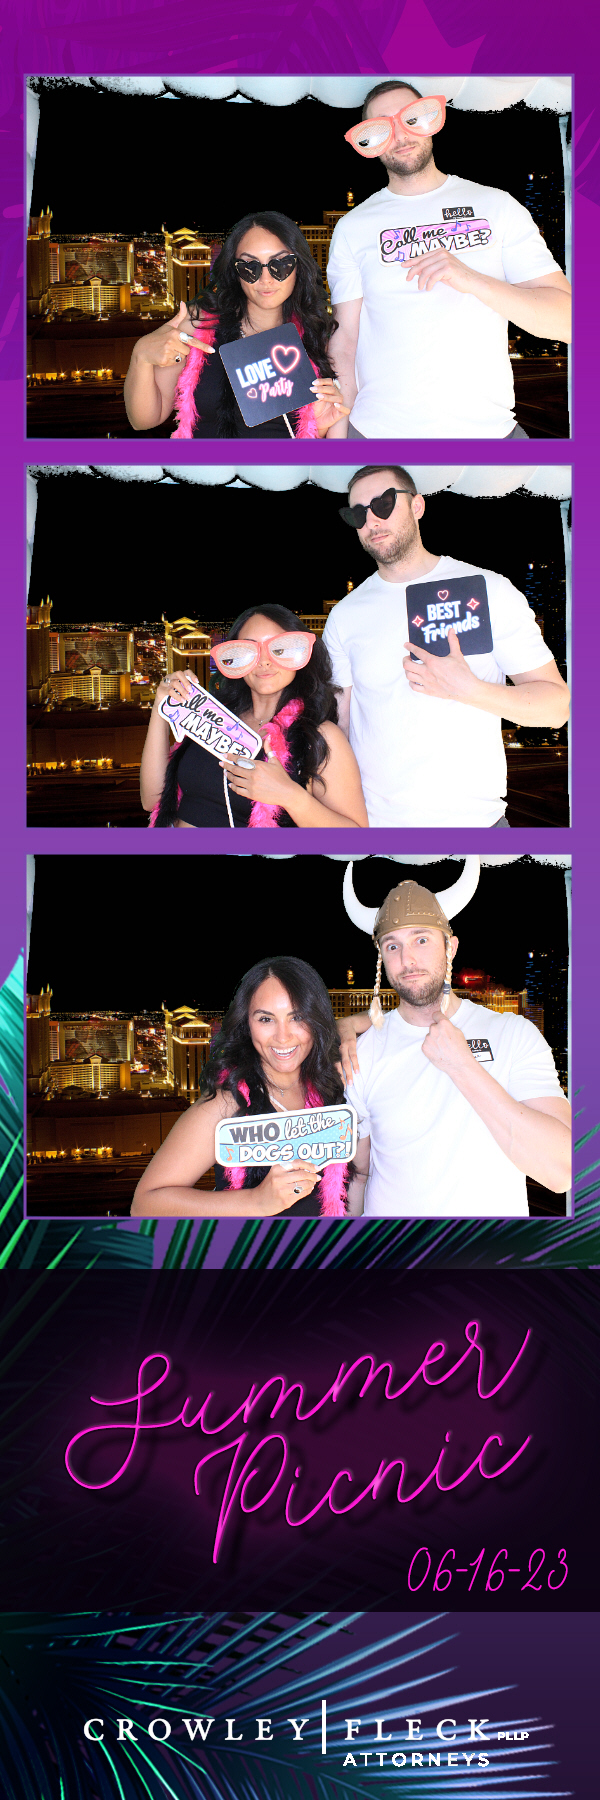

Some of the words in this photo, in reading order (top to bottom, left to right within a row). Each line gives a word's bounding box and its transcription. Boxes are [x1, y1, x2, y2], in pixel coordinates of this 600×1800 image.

[444, 207, 473, 218] hello
[381, 226, 418, 255] Call
[422, 228, 447, 240] me
[410, 228, 492, 258] MAYBE?
[235, 357, 277, 389] LOVE
[258, 376, 294, 403] Party
[426, 600, 461, 622] BEST
[421, 611, 480, 644] Friends
[203, 708, 224, 727] me
[467, 1039, 489, 1050] ello
[229, 1122, 280, 1144] WHO
[284, 1117, 308, 1140] let
[308, 1112, 337, 1134] the
[238, 1143, 294, 1162] DOGS
[297, 1141, 352, 1159] OUT?!
